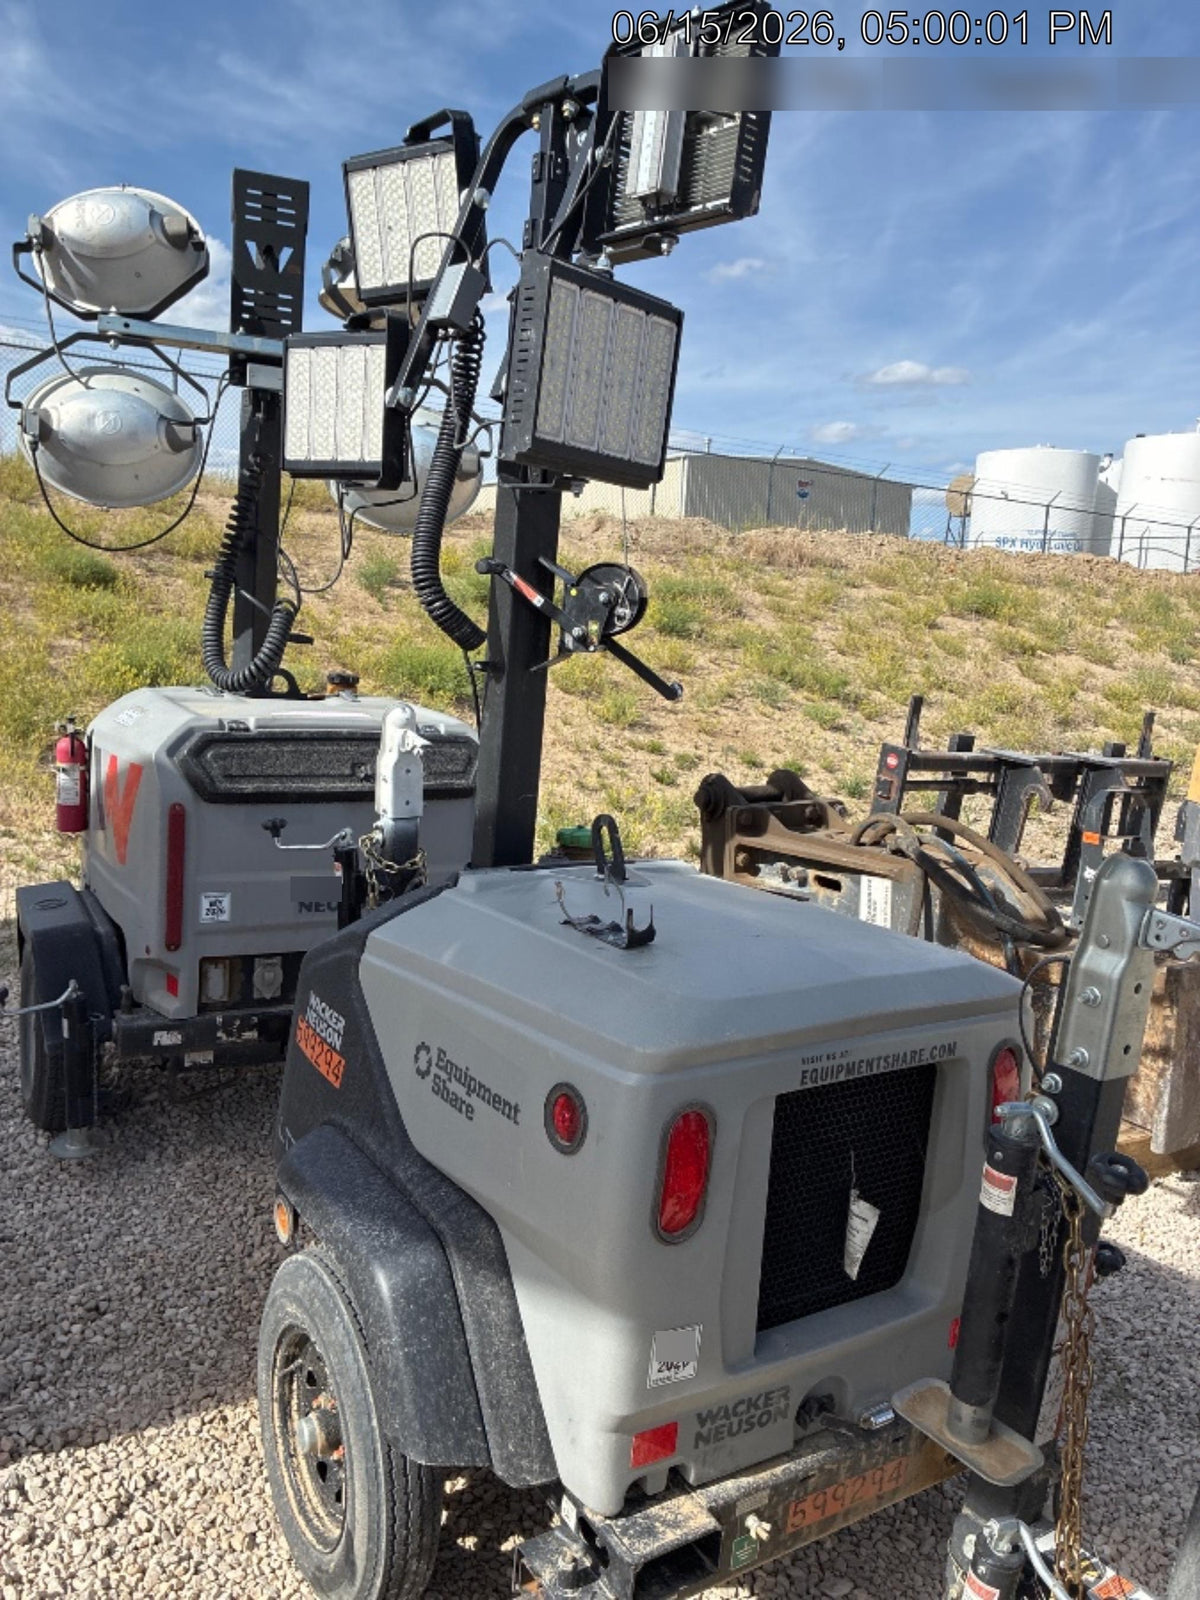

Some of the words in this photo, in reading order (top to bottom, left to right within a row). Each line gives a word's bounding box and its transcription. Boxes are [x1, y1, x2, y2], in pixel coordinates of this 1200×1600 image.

[305, 1006, 342, 1052] NEUSON
[435, 1047, 521, 1126] Equipment
[800, 1041, 957, 1086] EQUIPMENTSHARE.COM
[431, 1073, 474, 1121] Share
[694, 1402, 790, 1450] NEUSON
[696, 1385, 790, 1429] WACKER
[790, 1460, 907, 1528] 599294
